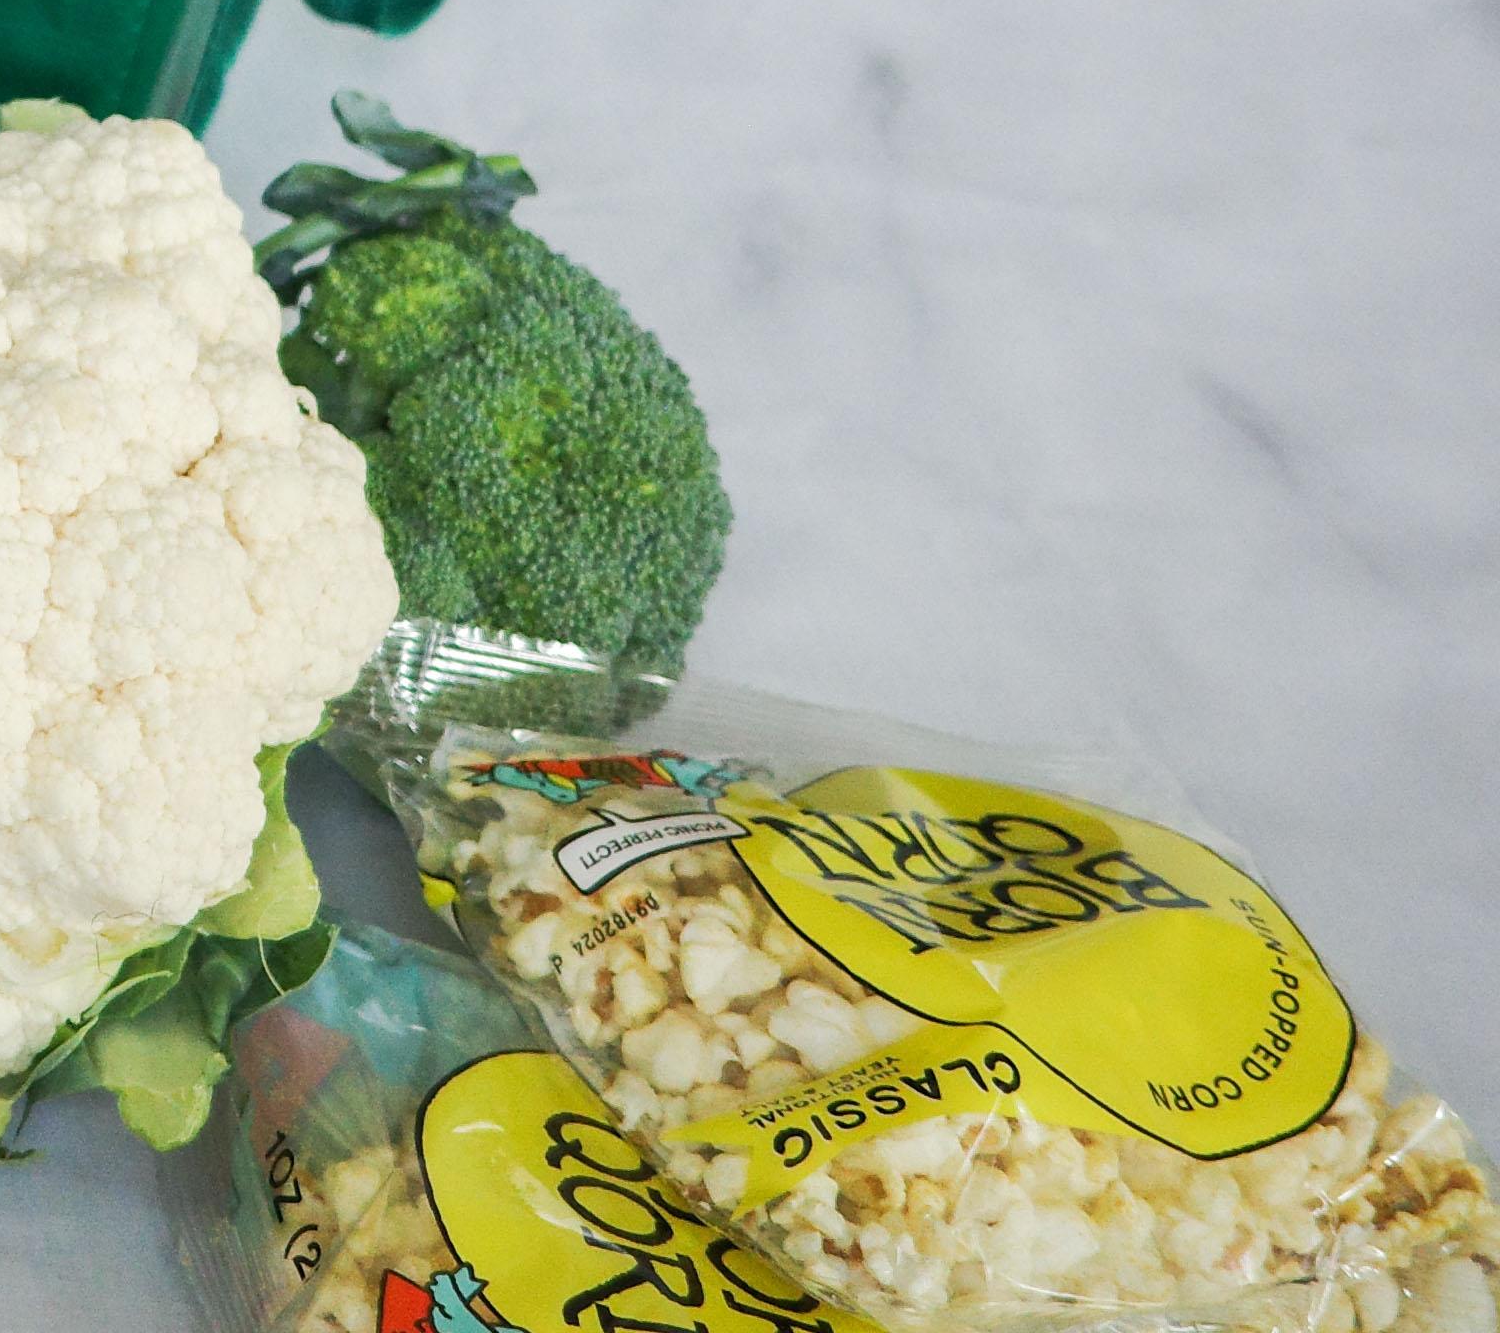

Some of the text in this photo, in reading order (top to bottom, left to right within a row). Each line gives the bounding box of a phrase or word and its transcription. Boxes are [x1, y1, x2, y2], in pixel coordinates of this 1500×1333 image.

[578, 829, 663, 871] PERFECT!
[750, 808, 1087, 889] QORN
[570, 891, 661, 958] 09182024
[1146, 895, 1302, 1113] SUN-POPPED CORN
[747, 1066, 901, 1131] NUTRITIONAL
[771, 1048, 1023, 1169] CLASSIC
